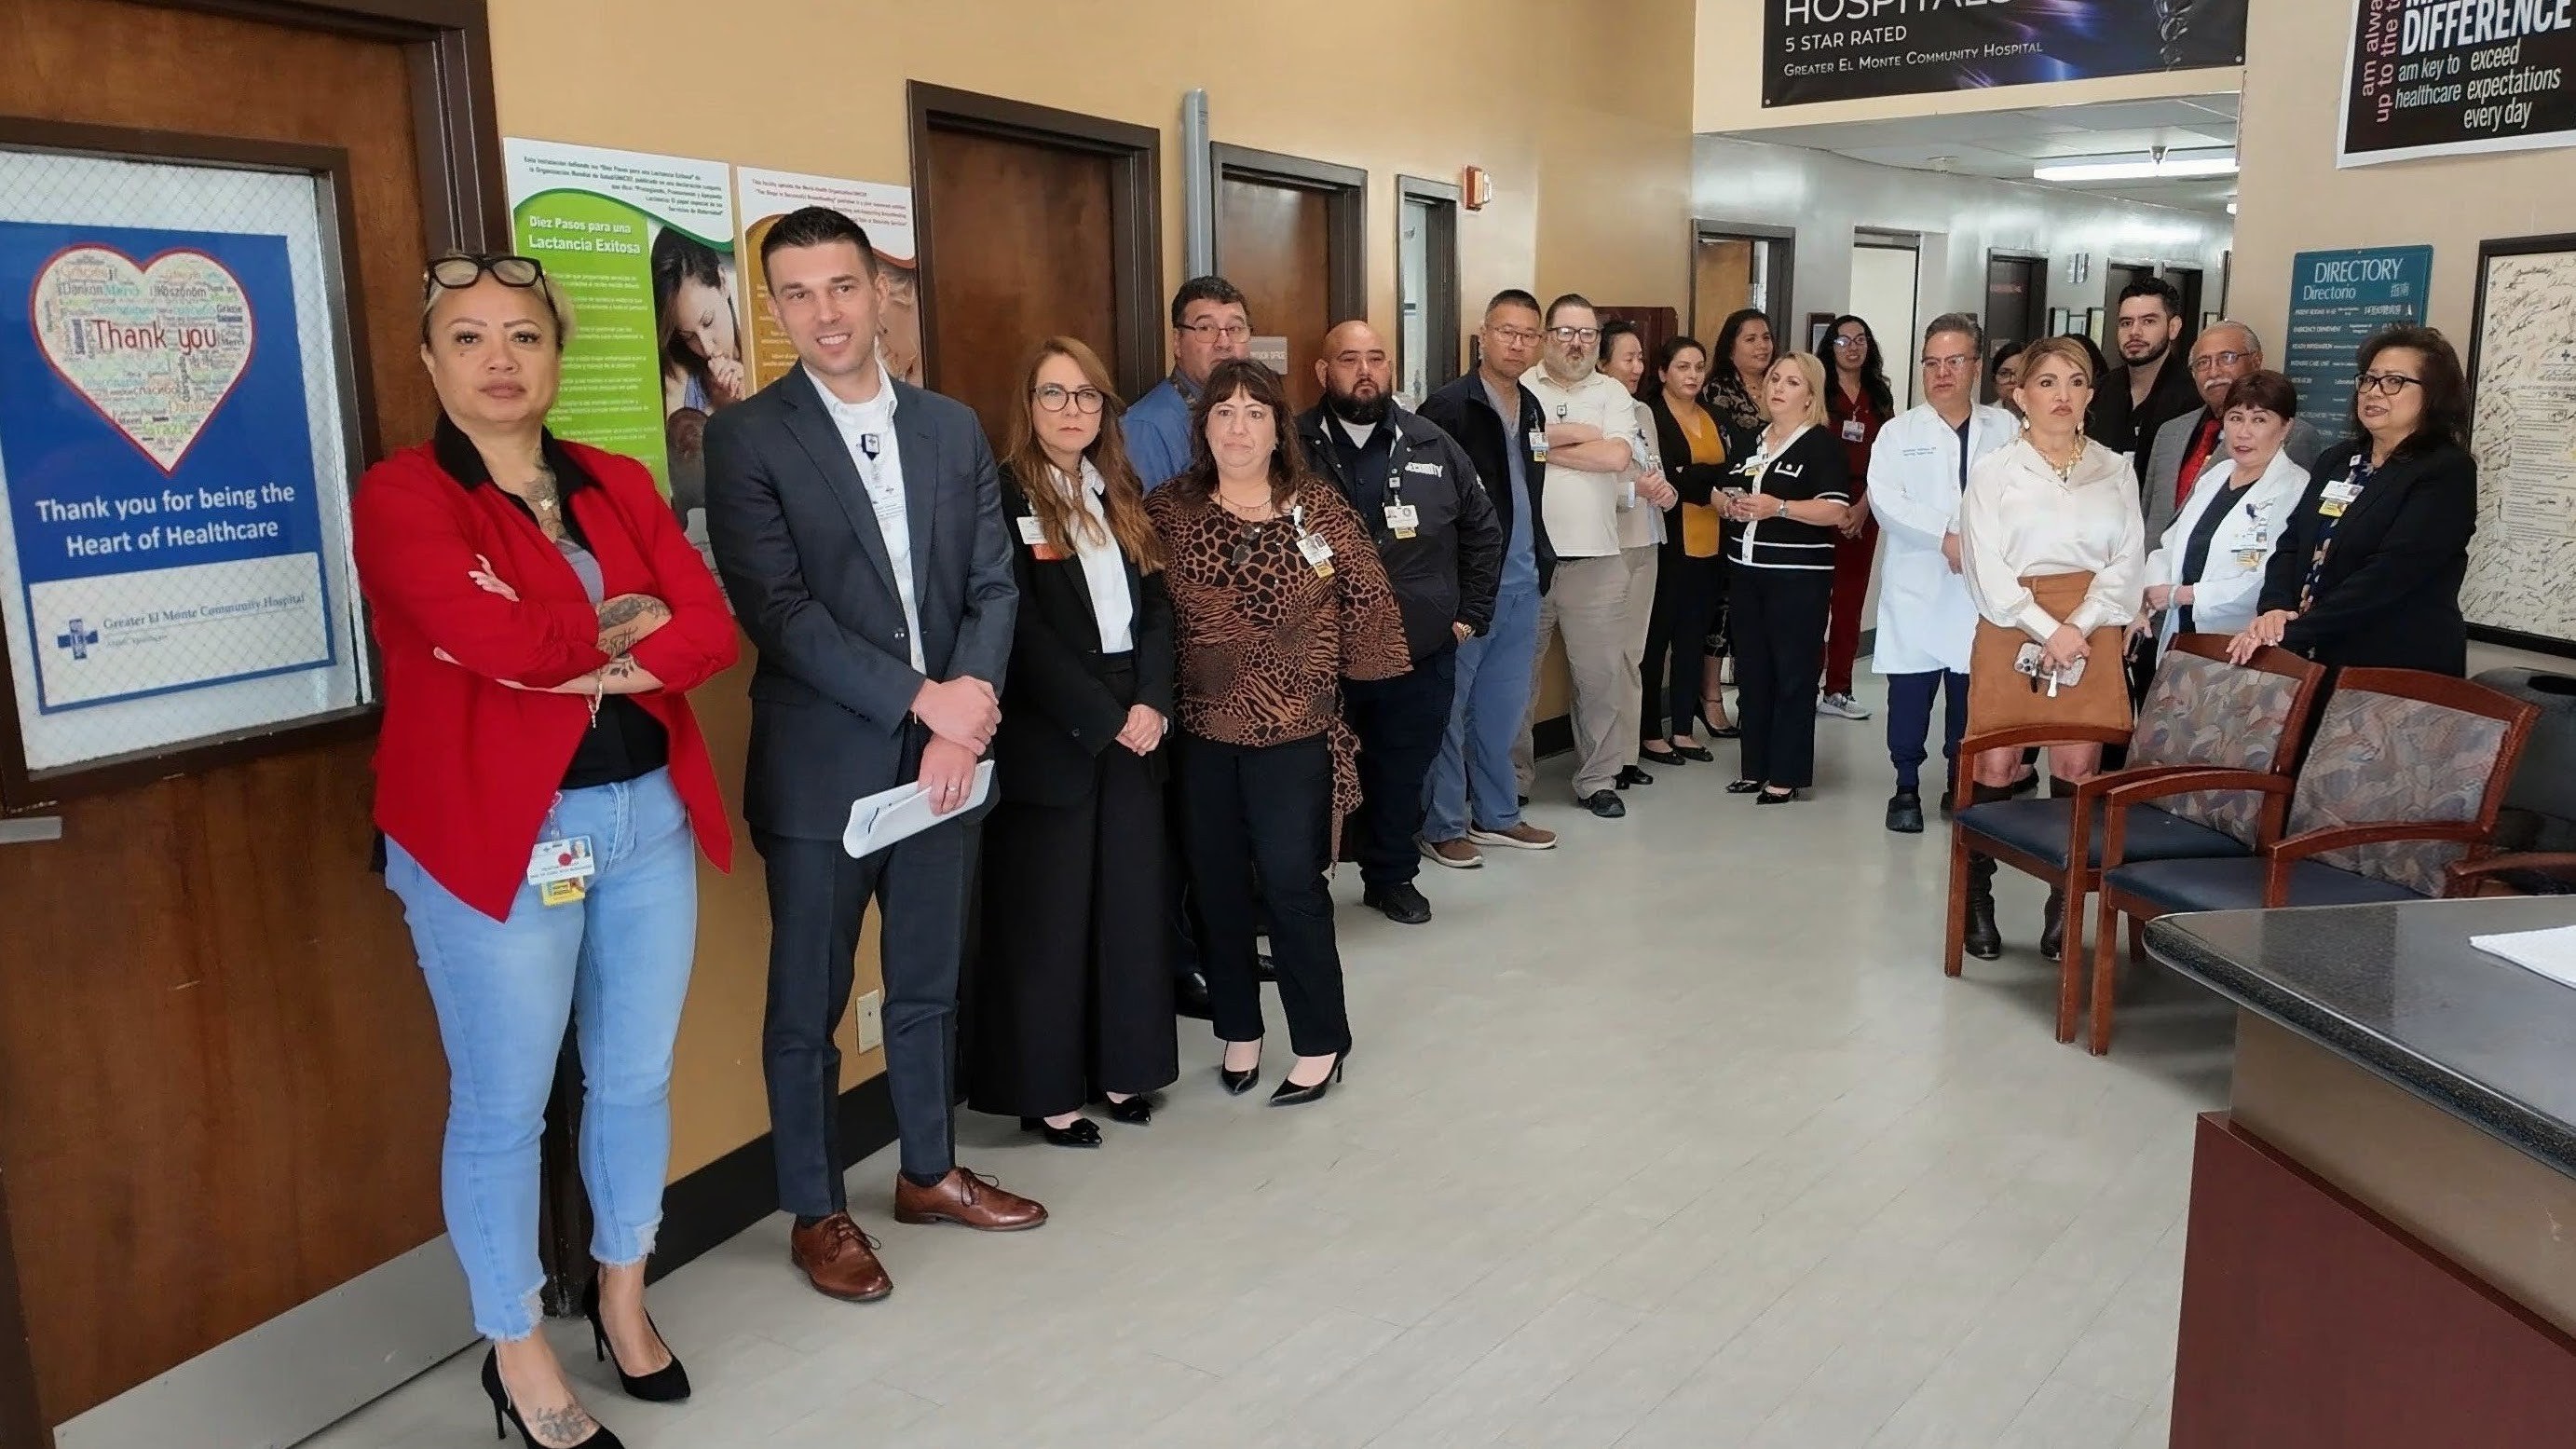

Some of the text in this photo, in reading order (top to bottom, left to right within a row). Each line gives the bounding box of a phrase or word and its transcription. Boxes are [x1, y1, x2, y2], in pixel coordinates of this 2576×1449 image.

[1784, 0, 2010, 26] HOSPI
[2401, 0, 2571, 55] DIFFERENCE
[1785, 25, 1907, 52] 5 STAR RATED
[2381, 19, 2400, 57] the
[2471, 37, 2522, 72] exceed
[1784, 61, 1834, 76] GREATER
[1860, 54, 1901, 70] MONTE
[1907, 47, 1979, 64] COMMUNITY
[1983, 41, 2043, 57] HOSPITAL
[2378, 63, 2394, 88] to
[2398, 54, 2460, 83] am key to
[2363, 60, 2377, 97] am
[2467, 66, 2562, 104] expectations
[2376, 94, 2394, 123] up
[2395, 84, 2461, 110] healthcare
[2464, 97, 2533, 132] every day
[529, 215, 632, 234] Diez Pasos para una
[529, 234, 641, 255] Lactancia Exitosa
[2314, 258, 2404, 283] DIRECTORY
[2303, 283, 2356, 301] Directorio
[90, 319, 217, 355] Thank you
[35, 482, 296, 524] Thank you for being the
[65, 519, 279, 558] Heart of Healthcare
[102, 616, 145, 630] Greater
[162, 607, 198, 622] Monte
[199, 597, 261, 616] Community
[262, 592, 306, 608] Hospital
